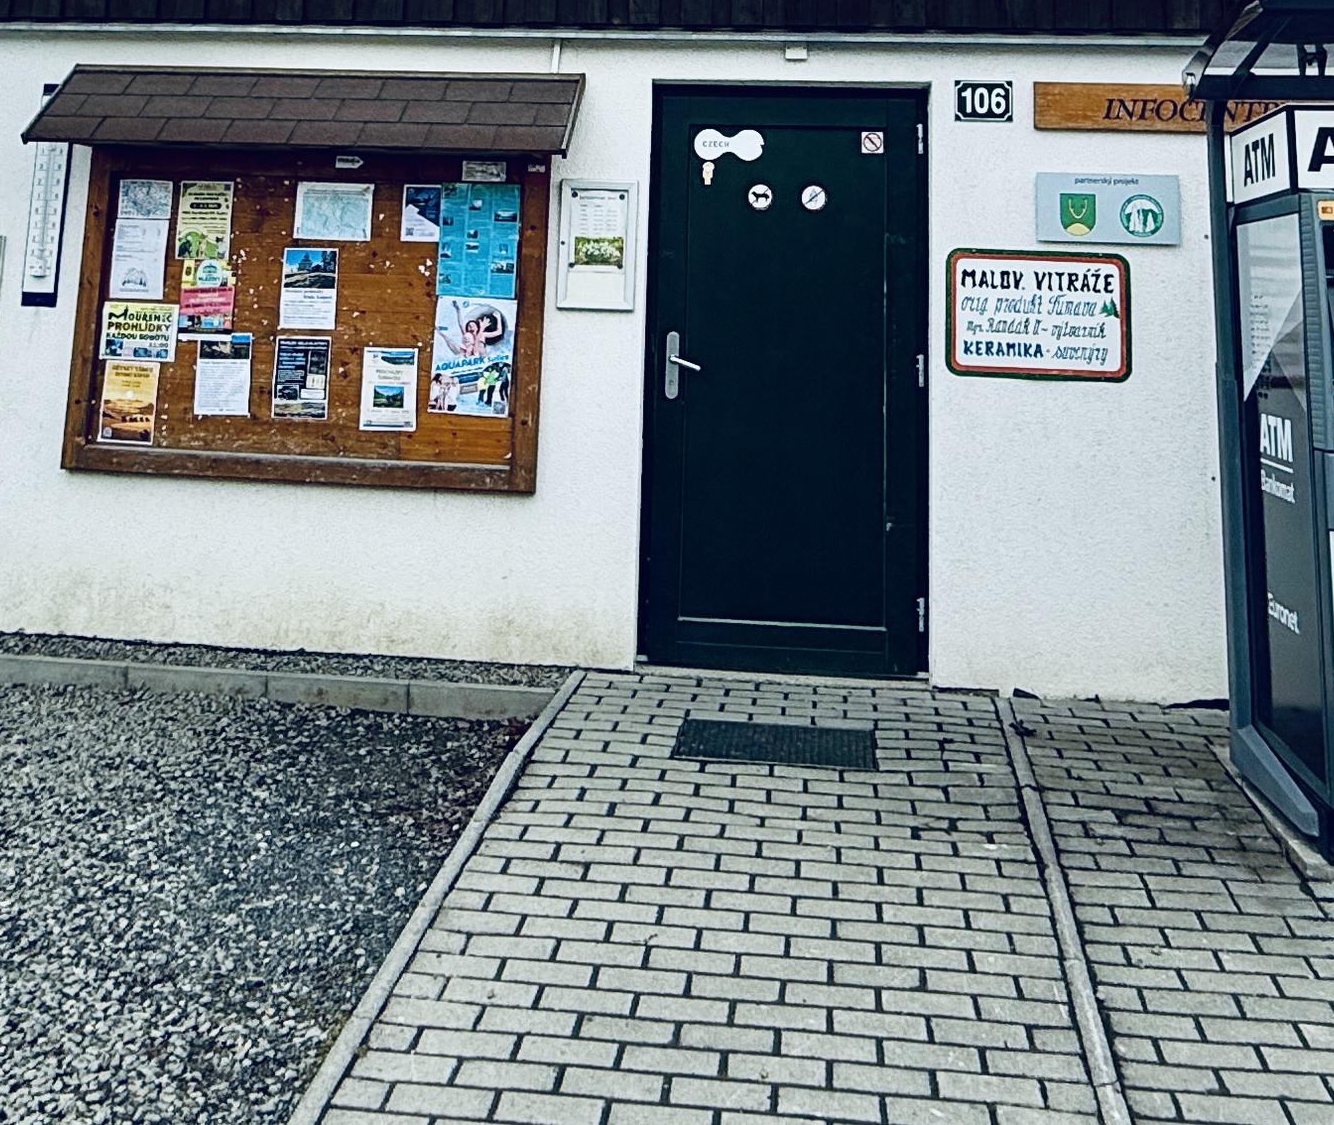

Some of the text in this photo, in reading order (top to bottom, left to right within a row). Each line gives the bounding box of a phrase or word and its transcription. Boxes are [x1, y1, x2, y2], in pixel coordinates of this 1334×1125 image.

[961, 87, 1007, 115] 106
[702, 140, 730, 148] CZECH
[1243, 133, 1276, 187] ATM
[1074, 176, 1140, 186] partnerský projekt
[960, 268, 1115, 294] MALOV. VITRÁŽE
[993, 293, 1043, 316] produkt
[107, 321, 171, 333] PROHLÍDKY
[963, 339, 1045, 359] KERAMIKA
[435, 356, 485, 372] AQUAPARK
[1260, 413, 1294, 463] ATM
